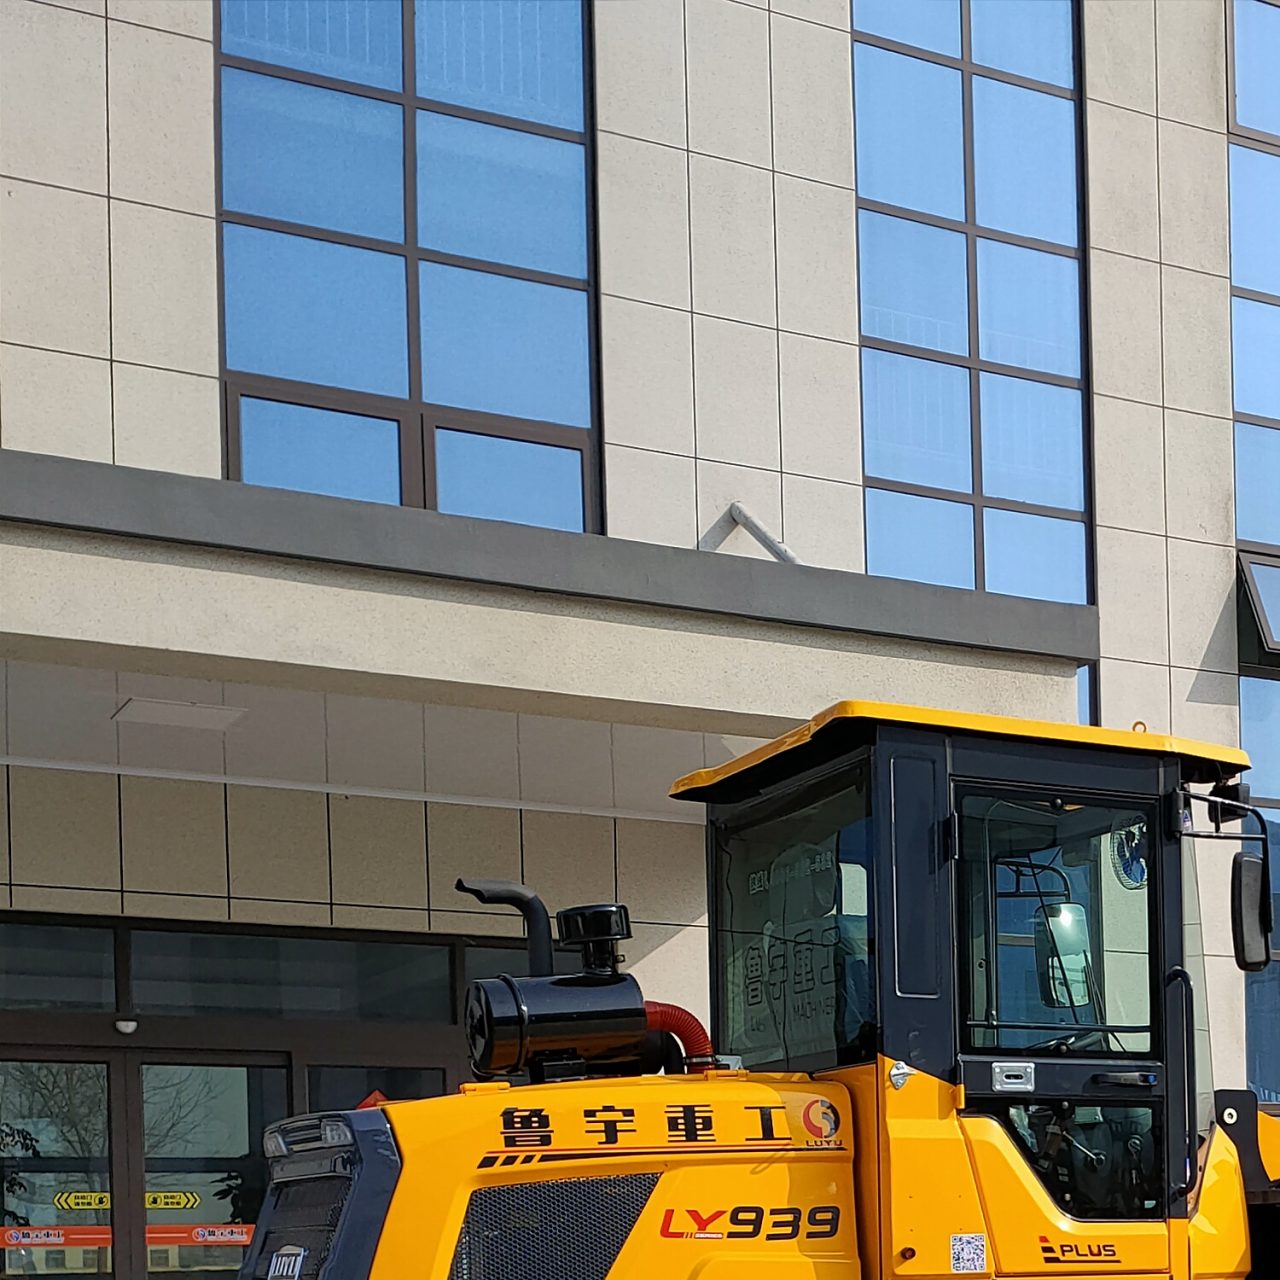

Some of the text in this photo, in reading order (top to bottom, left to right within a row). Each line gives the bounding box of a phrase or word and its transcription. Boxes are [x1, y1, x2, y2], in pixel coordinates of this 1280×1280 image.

[499, 1104, 793, 1147] 鲁宇重工
[805, 1139, 843, 1147] LUYU
[660, 1205, 841, 1241] LY939
[1059, 1244, 1117, 1257] PLUS
